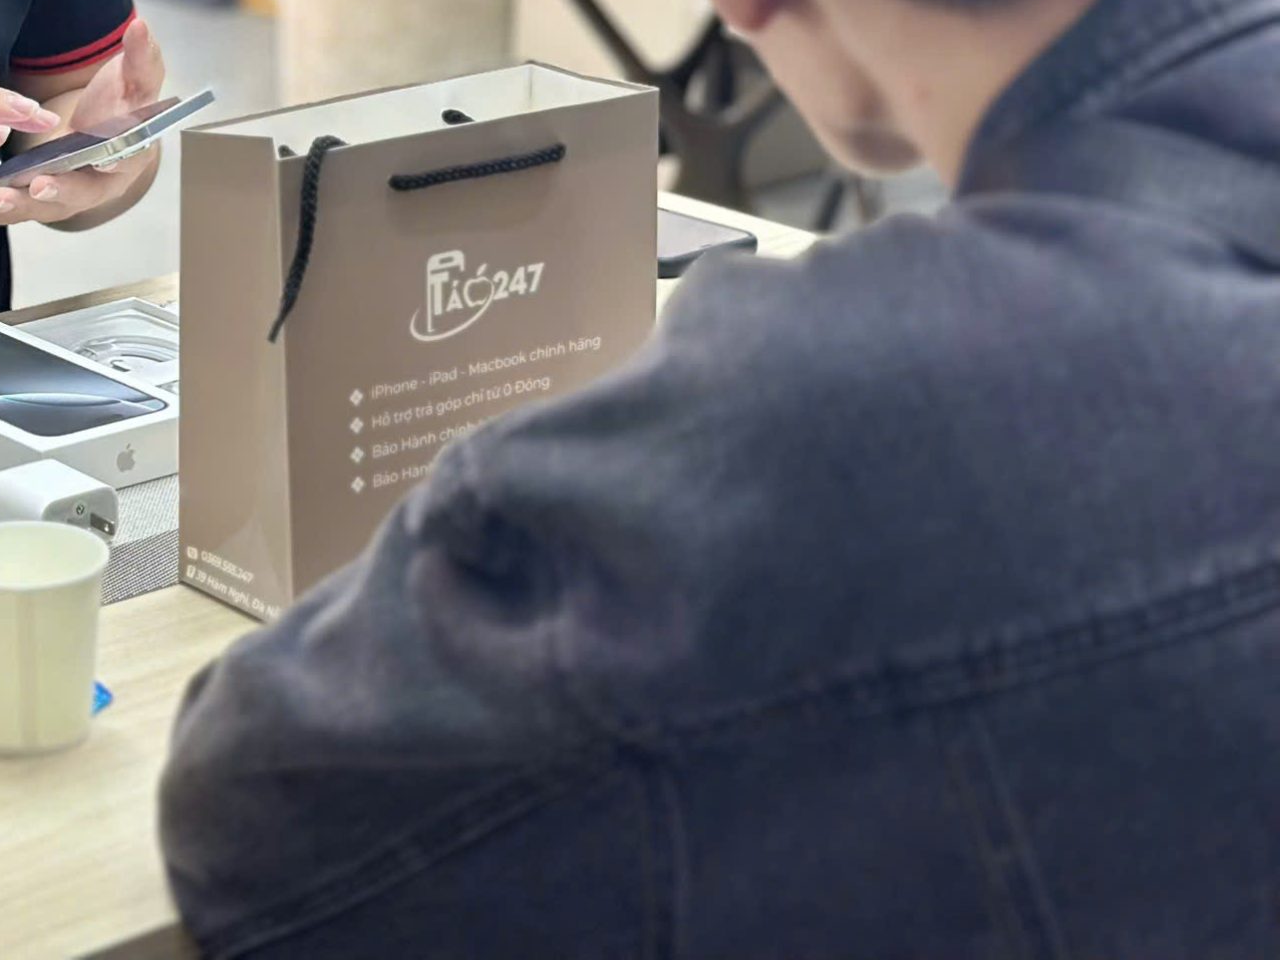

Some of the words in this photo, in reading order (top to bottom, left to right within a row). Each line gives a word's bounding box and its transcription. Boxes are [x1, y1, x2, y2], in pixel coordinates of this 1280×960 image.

[371, 379, 418, 399] iPhone
[429, 368, 458, 386] iPad
[468, 351, 526, 376] Macbook
[529, 342, 566, 361] chính
[569, 335, 601, 353] hãng
